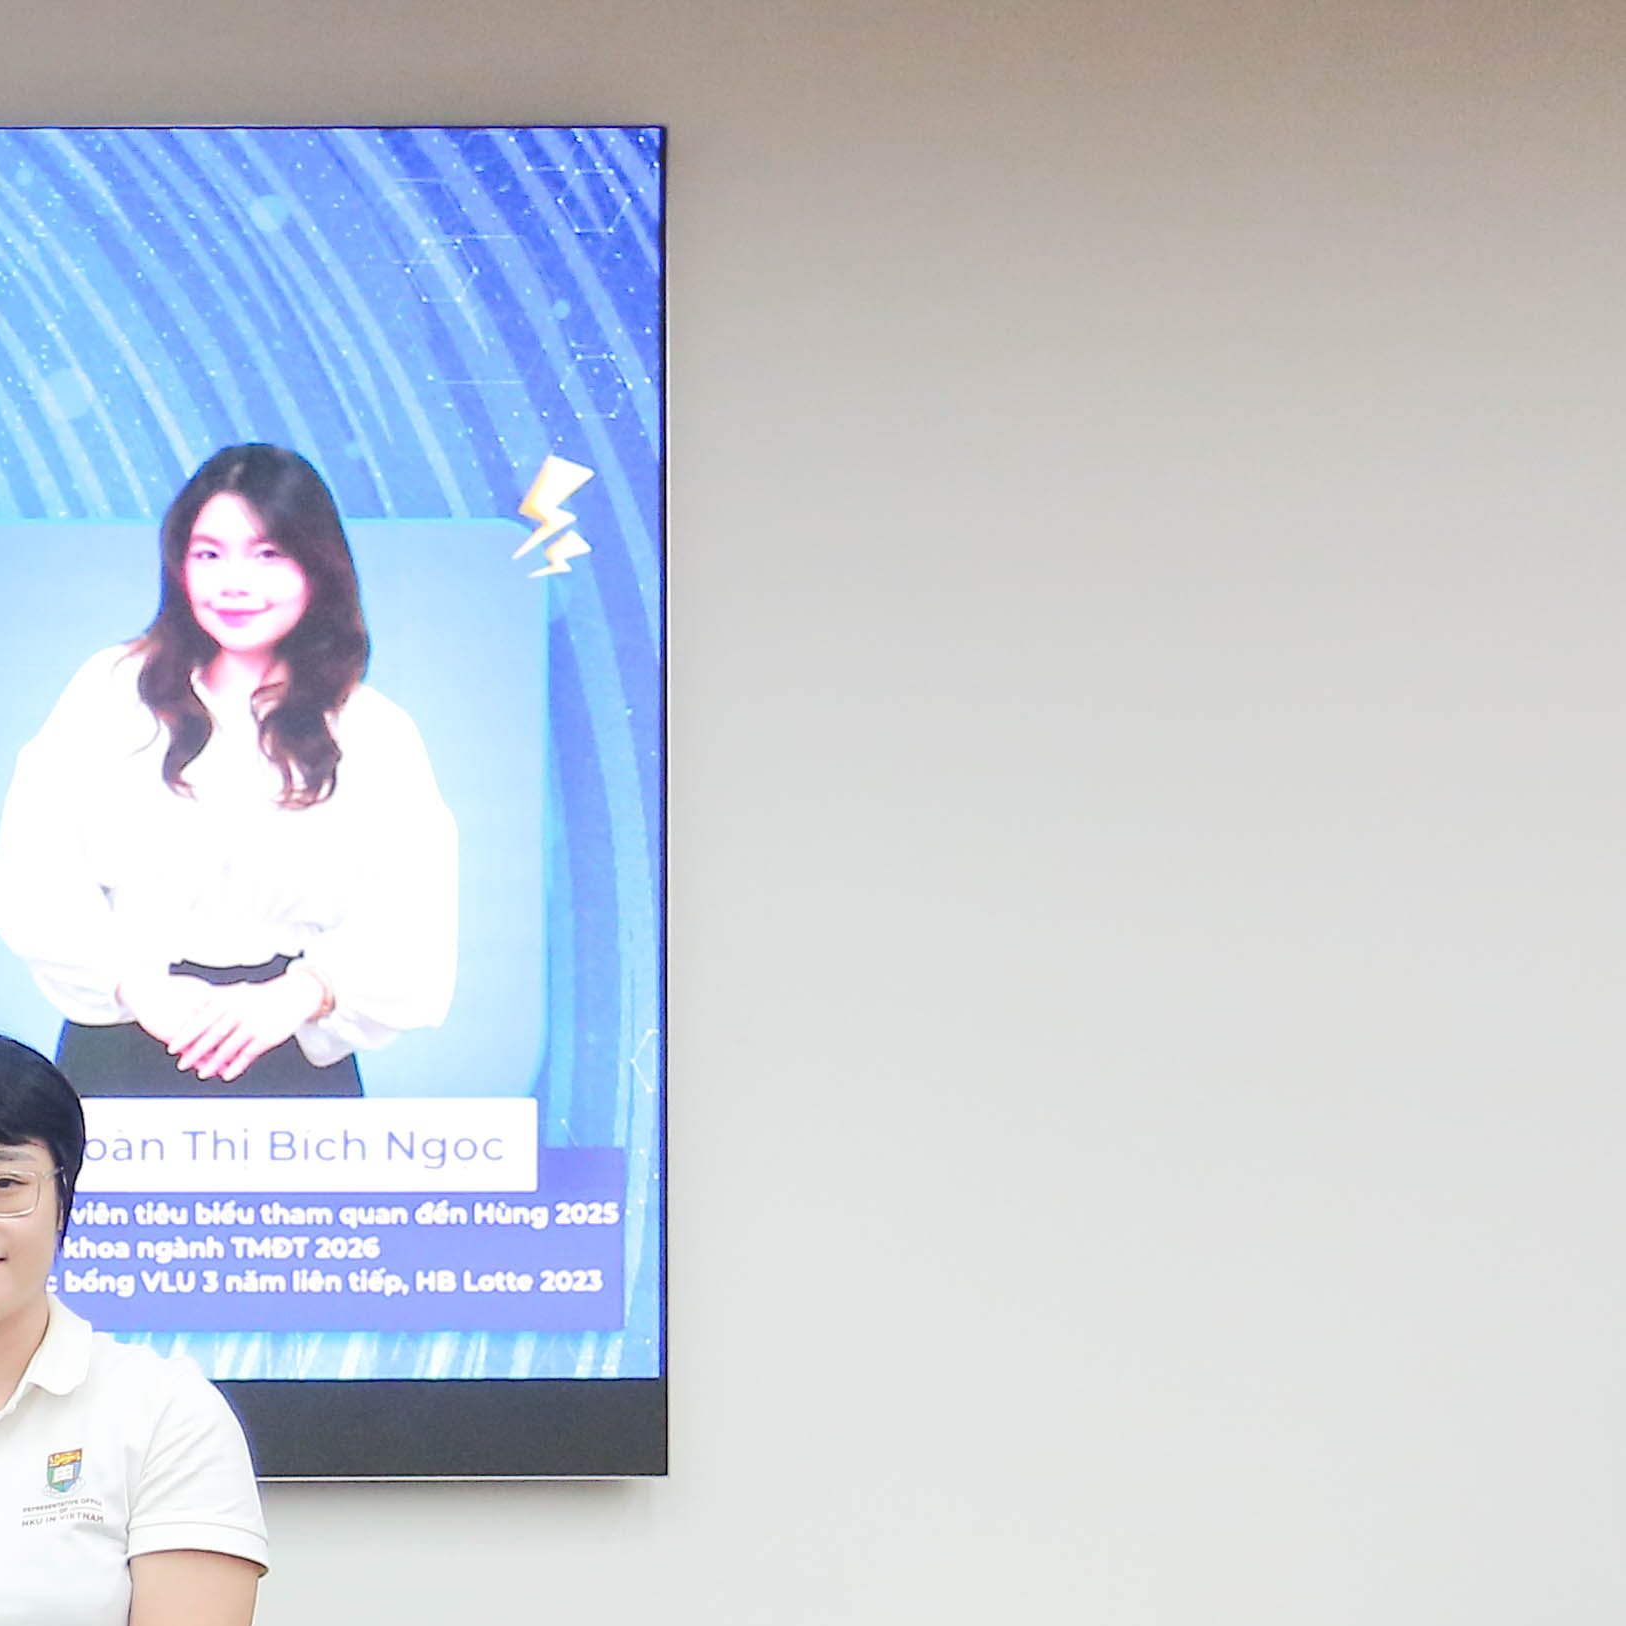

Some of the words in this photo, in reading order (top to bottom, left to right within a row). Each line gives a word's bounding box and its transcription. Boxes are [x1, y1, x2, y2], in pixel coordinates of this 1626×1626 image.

[83, 1127, 165, 1162] oàn
[71, 1201, 129, 1226] viên
[134, 1201, 189, 1226] tiêu
[259, 1202, 334, 1226] tham
[338, 1205, 409, 1230] quan
[414, 1199, 469, 1226] đến
[473, 1201, 549, 1230] Hùng
[554, 1202, 620, 1226] 2025
[63, 1235, 131, 1260] khoa
[136, 1235, 225, 1265] ngành
[230, 1236, 310, 1260] TMĐT
[315, 1235, 381, 1260] 2026
[140, 1269, 196, 1294] VLU
[201, 1269, 219, 1294] 3
[224, 1269, 287, 1294] năm
[292, 1268, 343, 1294] liên
[347, 1266, 410, 1298] tiếp,
[415, 1269, 457, 1294] HB
[462, 1269, 535, 1294] Lotte
[539, 1269, 604, 1294] 2023
